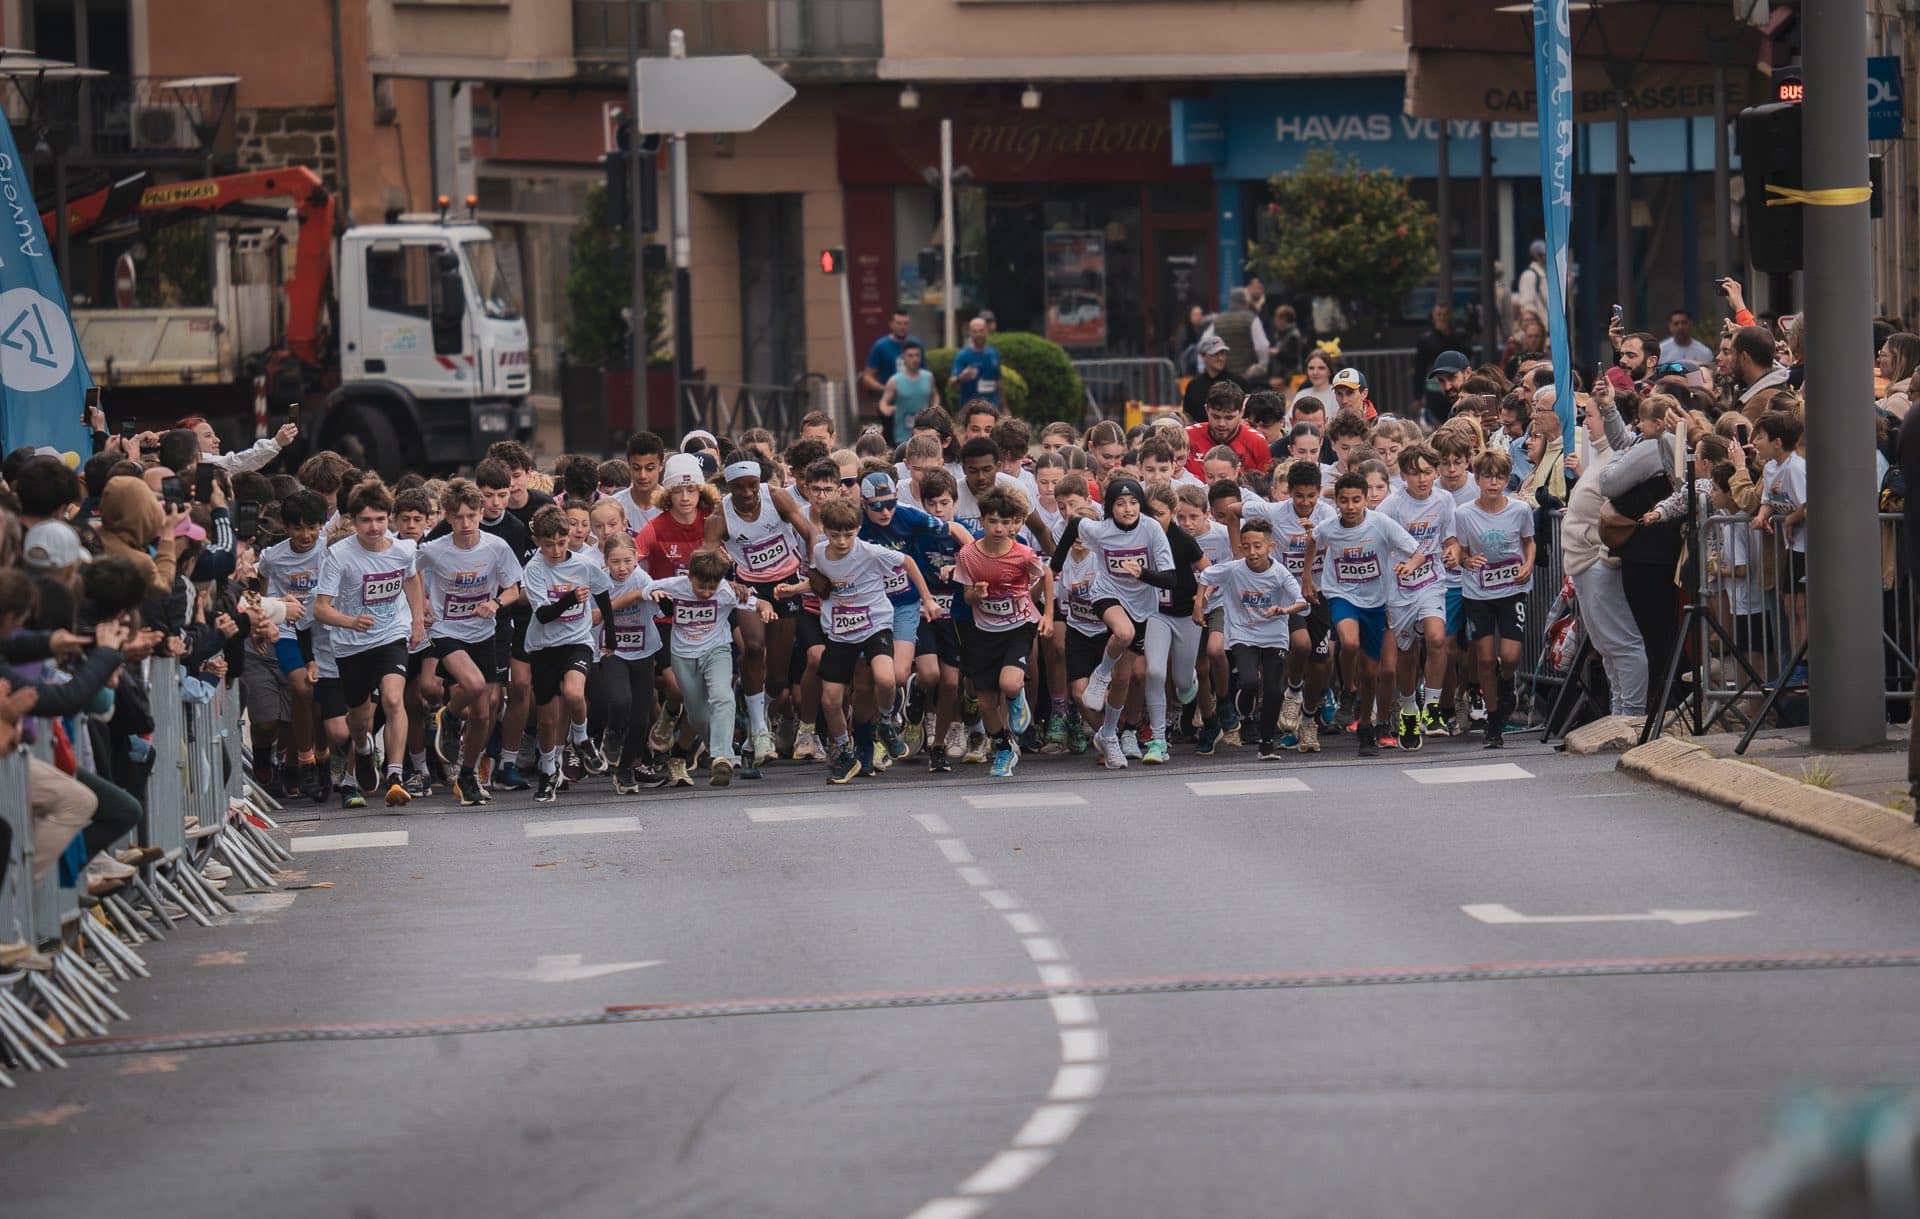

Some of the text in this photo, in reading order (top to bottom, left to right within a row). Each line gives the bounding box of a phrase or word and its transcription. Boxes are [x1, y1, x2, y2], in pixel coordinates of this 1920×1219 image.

[1484, 82, 1744, 113] CAF BRASSERE
[1780, 85, 1803, 99] BUS
[1866, 78, 1898, 107] OL
[1276, 114, 1538, 141] HAVAS VOYAGE
[751, 545, 783, 564] 2029
[1109, 558, 1144, 568] 200
[1289, 557, 1323, 569] 204
[1341, 563, 1375, 574] 2065
[1402, 566, 1429, 581] 123
[1485, 567, 1519, 581] 2126
[368, 580, 400, 594] 2108
[883, 575, 905, 589] 055
[449, 604, 476, 612] 214
[981, 602, 1010, 611] 169
[678, 609, 713, 619] 2145
[616, 634, 641, 643] 082
